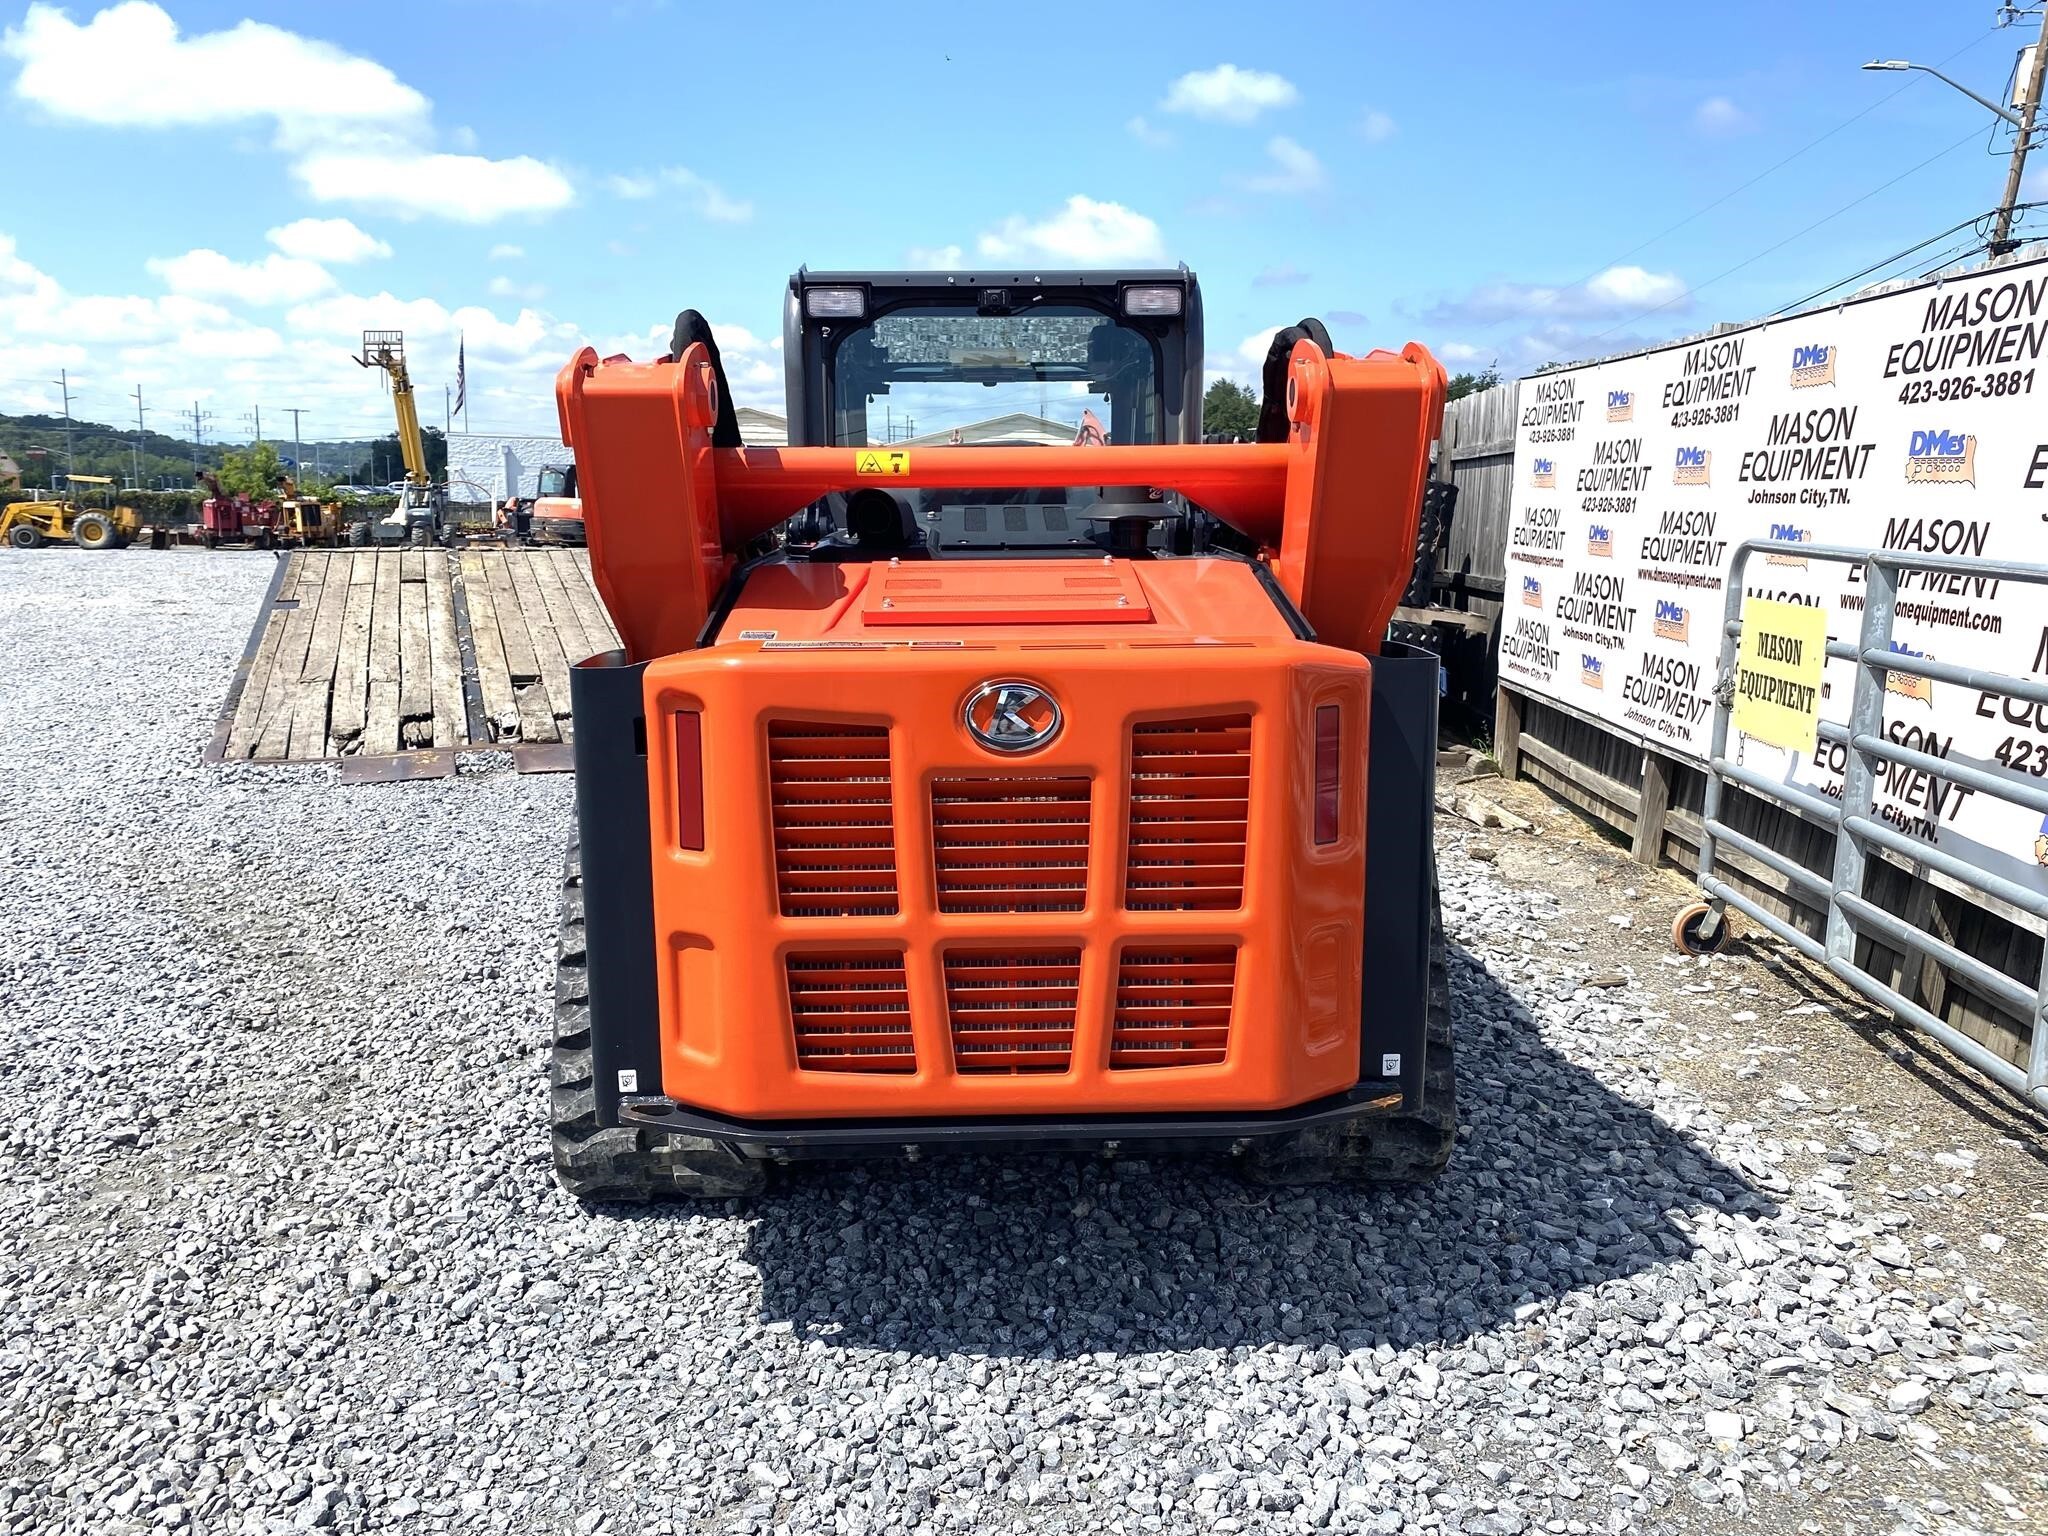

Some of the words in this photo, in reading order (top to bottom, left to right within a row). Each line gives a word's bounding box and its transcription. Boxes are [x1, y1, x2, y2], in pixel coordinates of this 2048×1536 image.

[1921, 276, 2048, 334] MASON
[1683, 338, 1744, 377] MASON
[1883, 320, 2048, 379] EQUIPMEN
[1536, 378, 1576, 404] MASON
[1662, 367, 1757, 408] EQUIPMENT
[1898, 368, 2036, 405] 423-926-3881
[1522, 400, 1585, 426] EQUIPMENT
[1671, 403, 1740, 429] 423-926-3881
[1767, 405, 1858, 446] MASON
[1529, 427, 1576, 444] 423-926-3881
[1593, 438, 1642, 465] MASON
[1738, 444, 1876, 482] EQUIPMENT
[1576, 466, 1652, 491] EQUIPMENT
[1581, 497, 1637, 513] 423-926-3881
[1748, 489, 1797, 504] Johnson
[1524, 507, 1561, 528] MASON
[1659, 511, 1717, 537] MASON
[1513, 527, 1566, 550] EQUIPMENT
[1882, 518, 1990, 556] MASON
[1641, 537, 1727, 567] EQUIPMENT
[1573, 572, 1624, 602] MASON
[1637, 567, 1722, 590] www.dmasonequipment.com
[1556, 596, 1637, 633] EQUIPMENT
[1515, 617, 1550, 645] MASON
[1563, 625, 1593, 642] Johnson
[1501, 635, 1560, 671] EQUIPMENT
[1757, 632, 1803, 667] MASON
[1508, 660, 1530, 676] Johnson
[1642, 652, 1700, 691] MASON
[1622, 675, 1712, 725] EQUIPMENT
[1739, 669, 1816, 714] EQUIPMENT
[1624, 707, 1656, 728] Johnson
